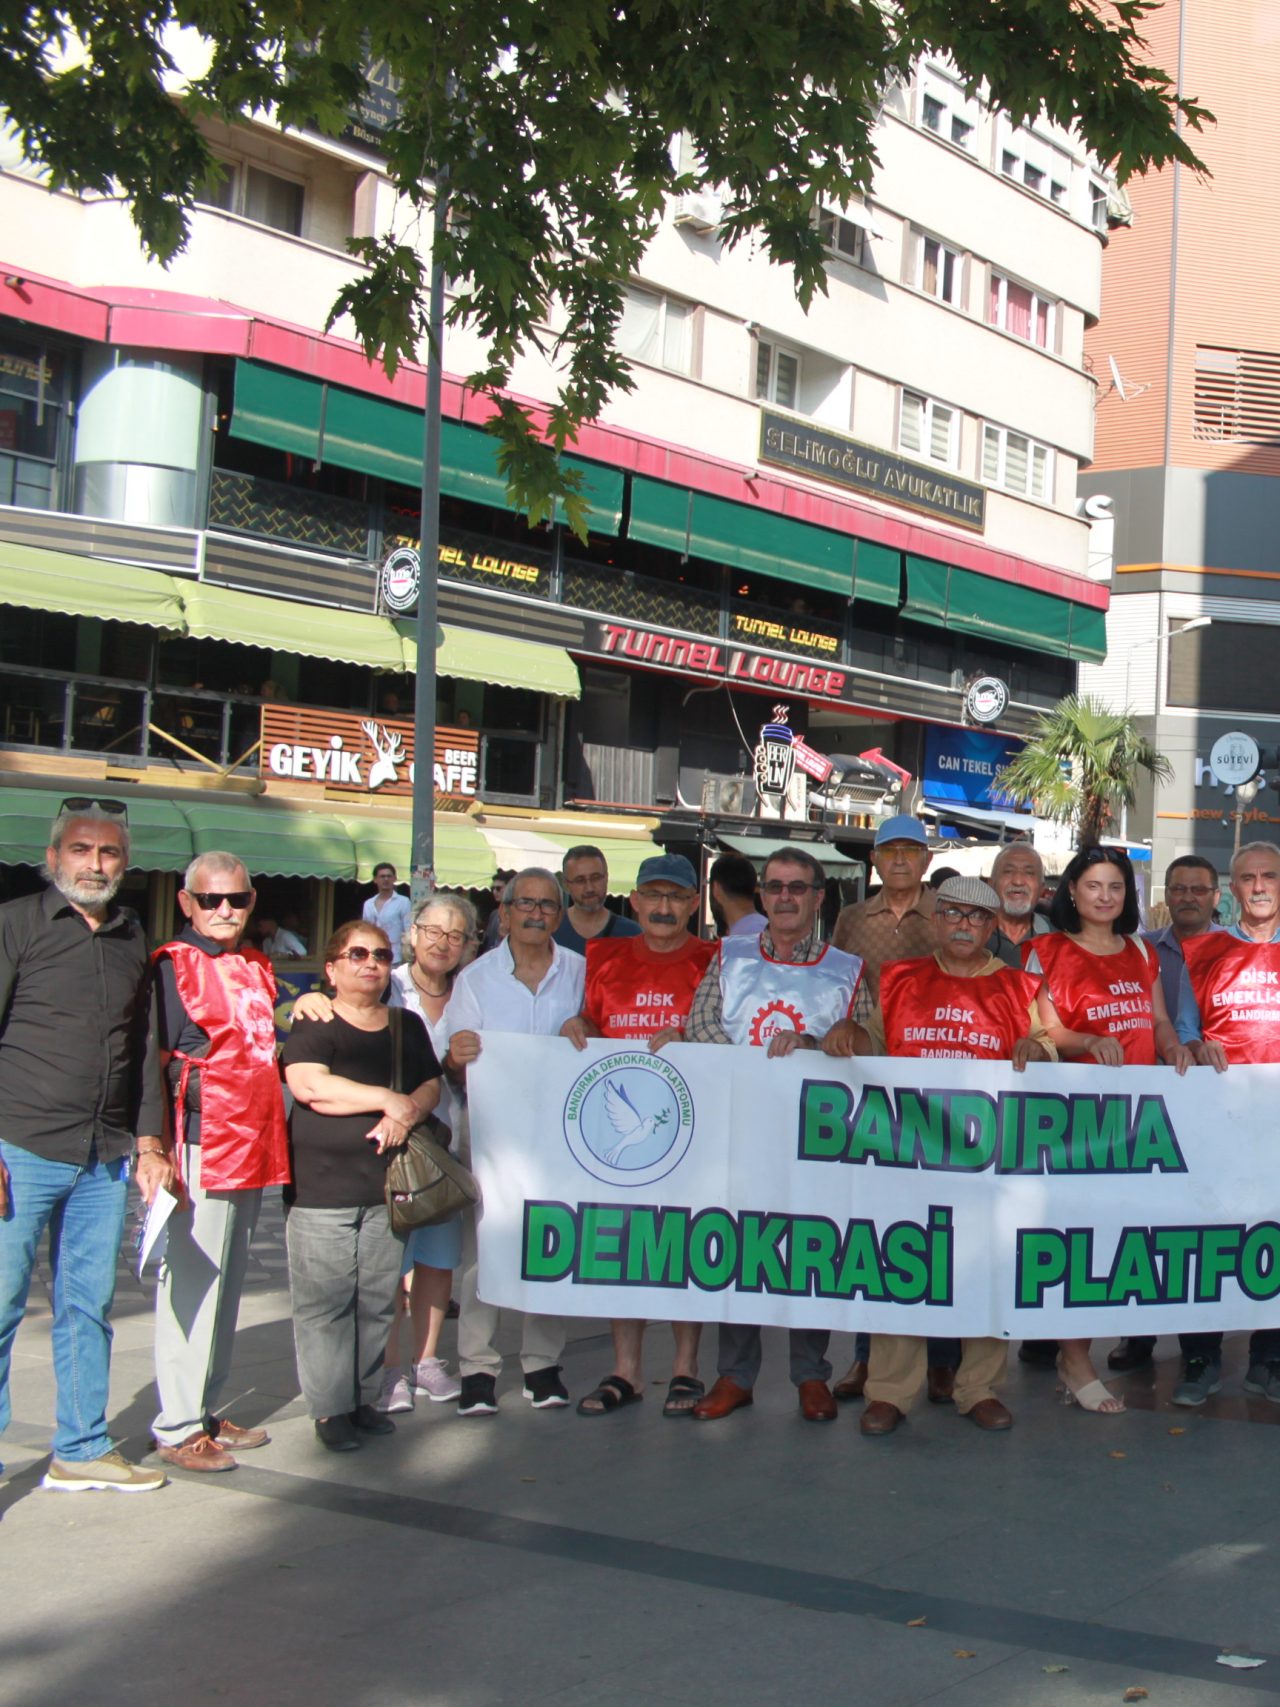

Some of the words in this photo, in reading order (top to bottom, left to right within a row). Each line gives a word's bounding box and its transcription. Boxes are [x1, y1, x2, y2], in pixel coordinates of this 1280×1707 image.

[884, 467, 981, 517] AVUKATLIK
[269, 735, 362, 784] GEYİK
[445, 749, 478, 766] BEER
[938, 755, 960, 771] CAN
[963, 759, 993, 776] TEKEL
[1217, 754, 1253, 764] SÜTEVİ
[409, 763, 477, 795] AFE
[1109, 980, 1144, 995] DİSK
[1240, 968, 1279, 984] DİSK
[636, 990, 675, 1007] DİSK
[935, 1004, 974, 1024] DİSK
[904, 1026, 1000, 1051] EMEKLİ-SEN
[567, 1068, 601, 1121] BANDIRMA
[599, 1054, 663, 1073] DEMOKRASİ
[662, 1065, 691, 1127] PLATFORMU
[798, 1079, 1189, 1176] BANDIRMA
[520, 1199, 954, 1307] DEMOKRASİ
